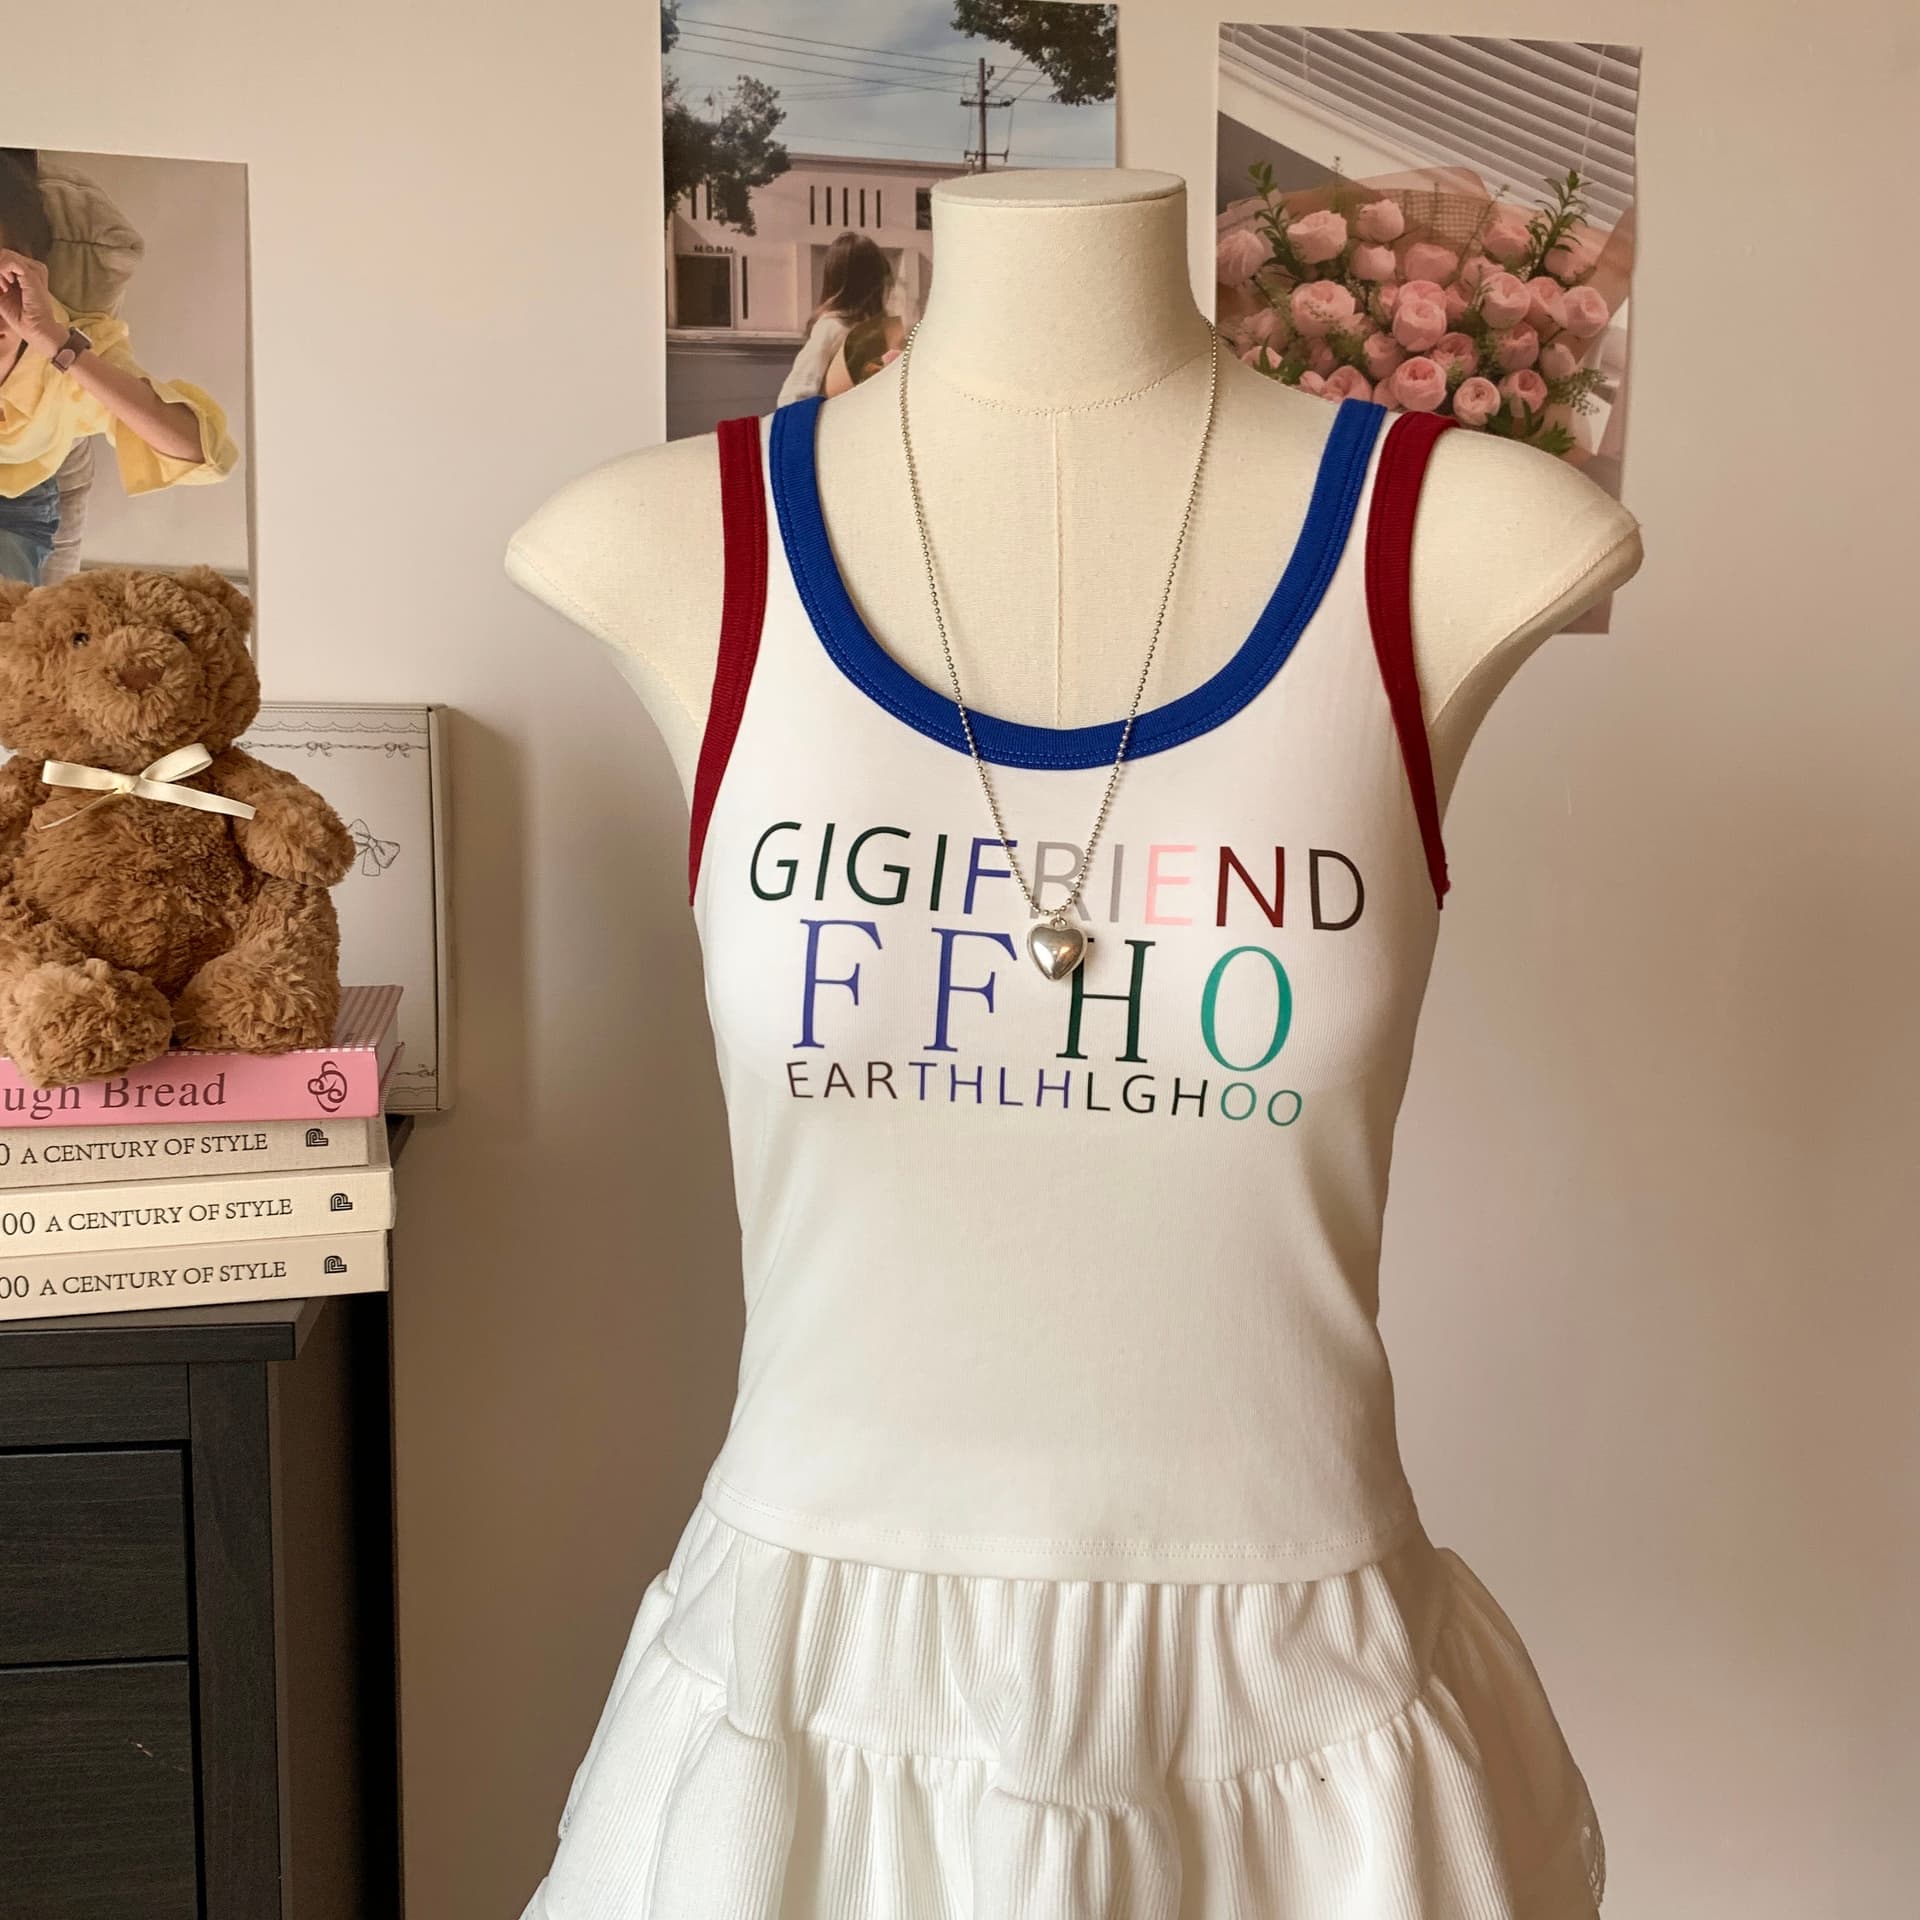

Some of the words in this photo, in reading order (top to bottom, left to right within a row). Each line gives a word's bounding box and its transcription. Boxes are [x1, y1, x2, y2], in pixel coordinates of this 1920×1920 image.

[750, 821, 1364, 932] GIGIFRIEND
[101, 1072, 226, 1109] Bread
[786, 1061, 1303, 1127] EARTHLHLGHOO
[20, 1147, 39, 1165] A
[43, 1139, 158, 1163] CENTURY
[164, 1137, 195, 1156] OF
[200, 1133, 268, 1154] STYLE
[45, 1215, 64, 1233] A
[68, 1206, 184, 1231] CENTURY
[189, 1203, 220, 1222] OF
[225, 1198, 293, 1220] STYLE
[39, 1279, 58, 1297] A
[62, 1269, 178, 1294] CENTURY
[183, 1266, 214, 1285] OF
[219, 1260, 287, 1283] STYLE
